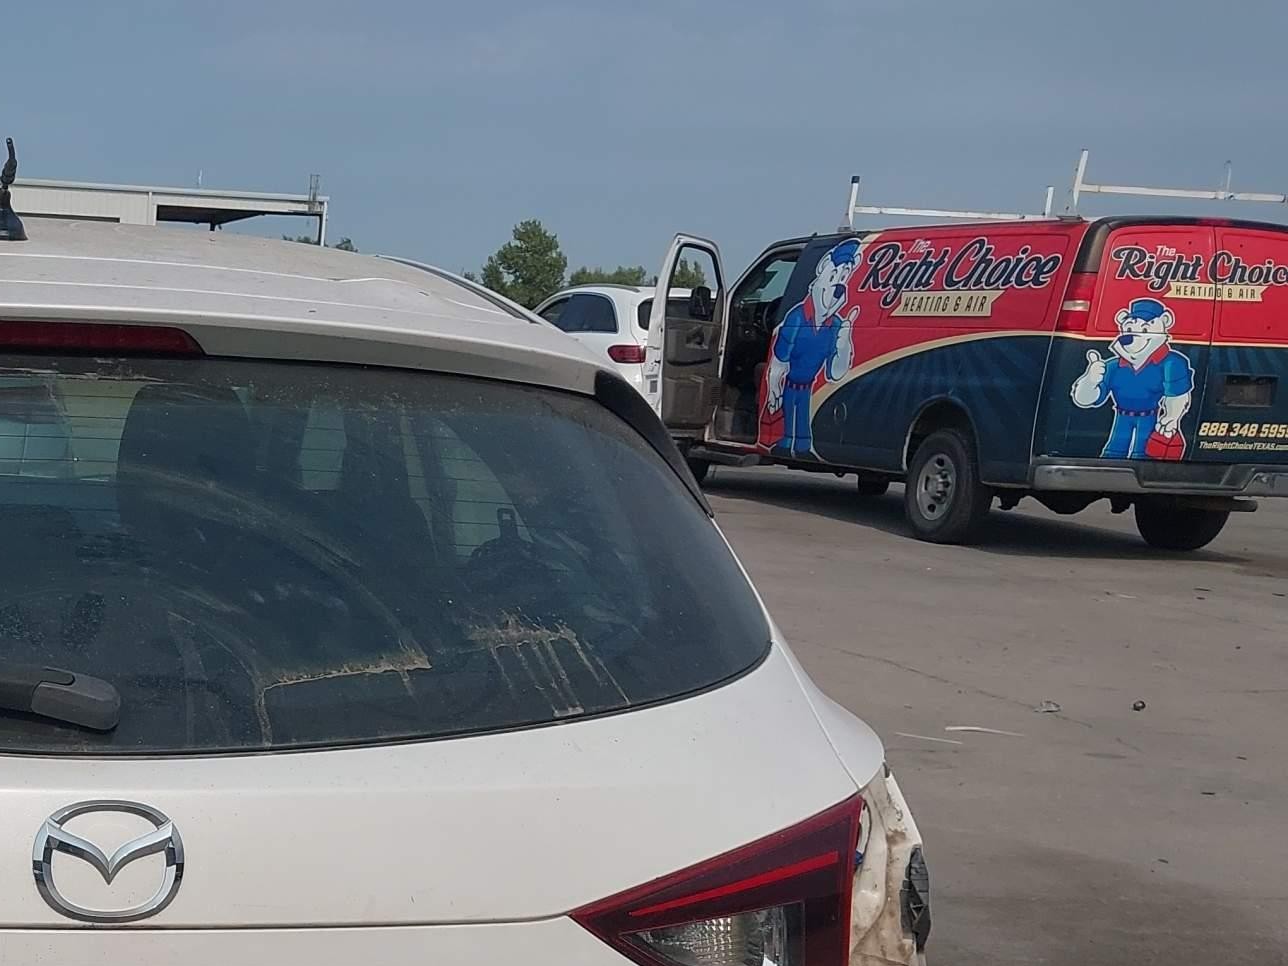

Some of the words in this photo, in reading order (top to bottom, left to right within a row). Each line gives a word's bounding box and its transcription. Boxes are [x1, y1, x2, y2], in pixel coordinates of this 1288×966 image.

[908, 239, 931, 253] The
[1156, 245, 1176, 256] The
[858, 242, 951, 309] Right
[943, 236, 1063, 290] Choice
[1112, 245, 1203, 292] Right
[1208, 250, 1288, 286] Choic
[1175, 285, 1222, 298] HEATING
[1238, 288, 1256, 299] AIR
[902, 296, 948, 312] HEATING
[965, 295, 987, 312] AIR
